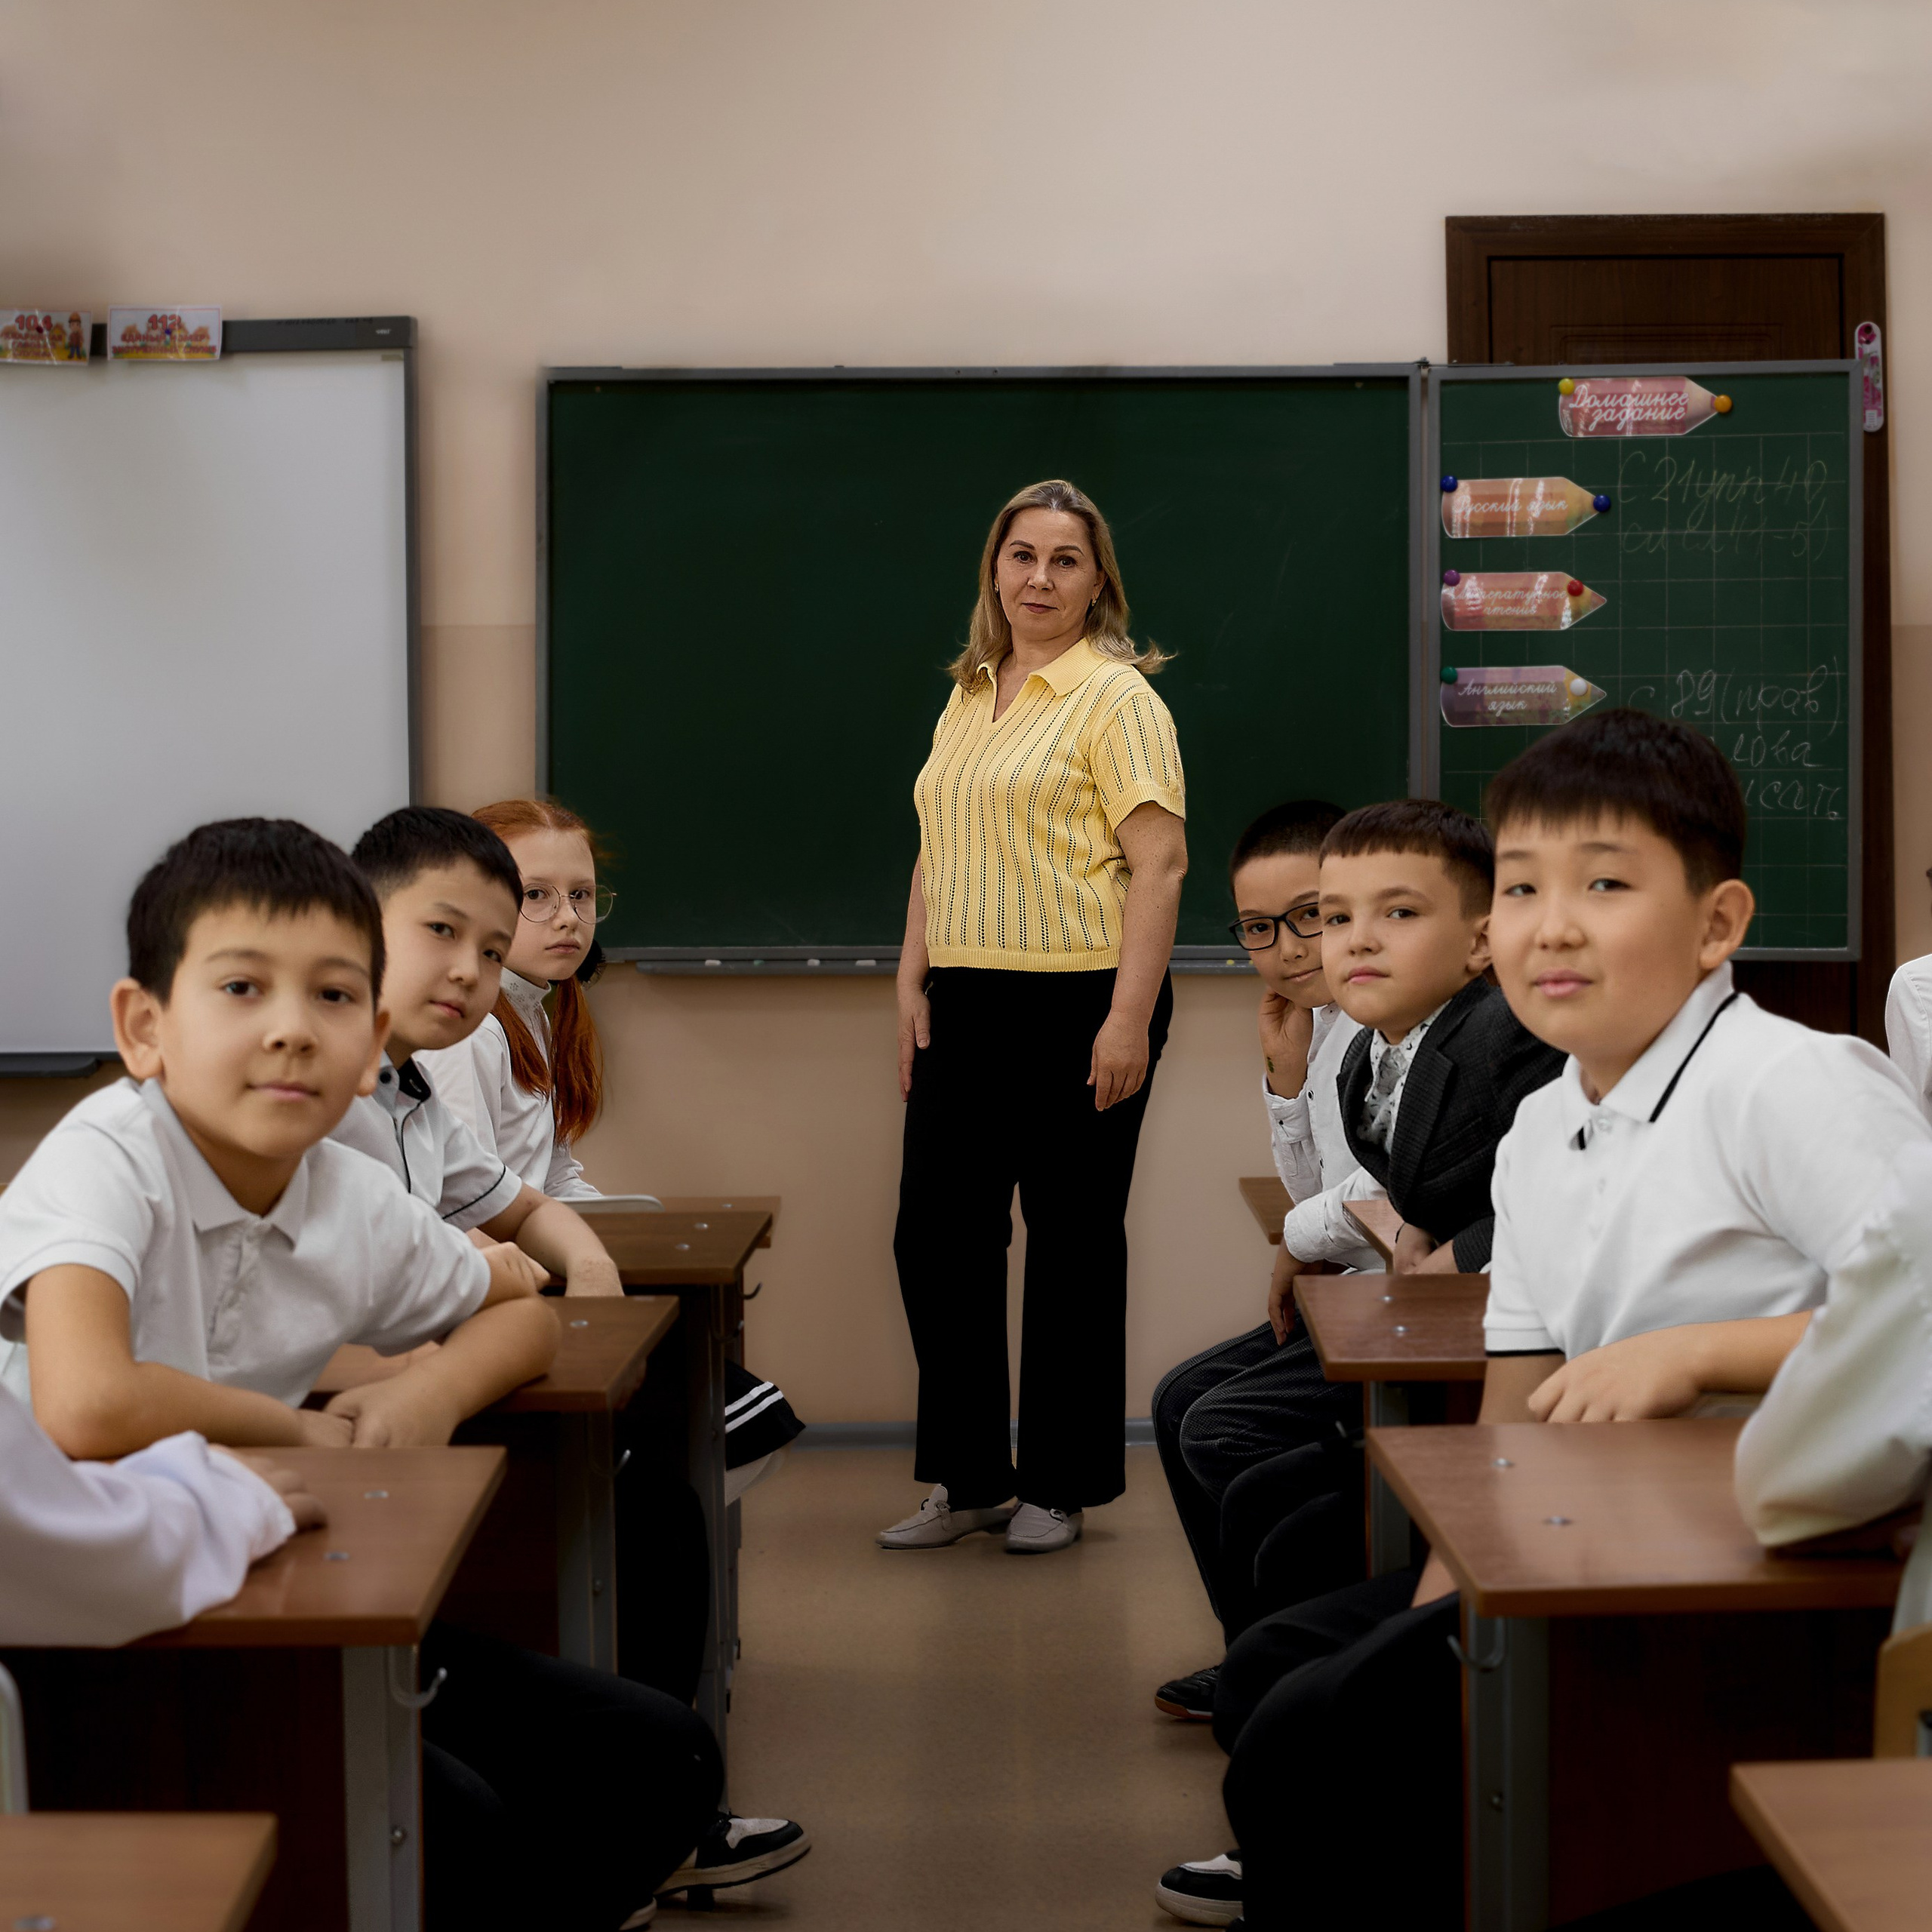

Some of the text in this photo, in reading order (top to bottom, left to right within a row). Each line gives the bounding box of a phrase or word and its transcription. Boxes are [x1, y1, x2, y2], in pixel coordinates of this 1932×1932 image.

[148, 314, 181, 331] 112
[1569, 384, 1689, 408] Домашнее
[1589, 407, 1686, 431] задание
[1457, 495, 1567, 519] Русский язык
[1458, 679, 1557, 696] Английский
[1488, 700, 1527, 716] язык
